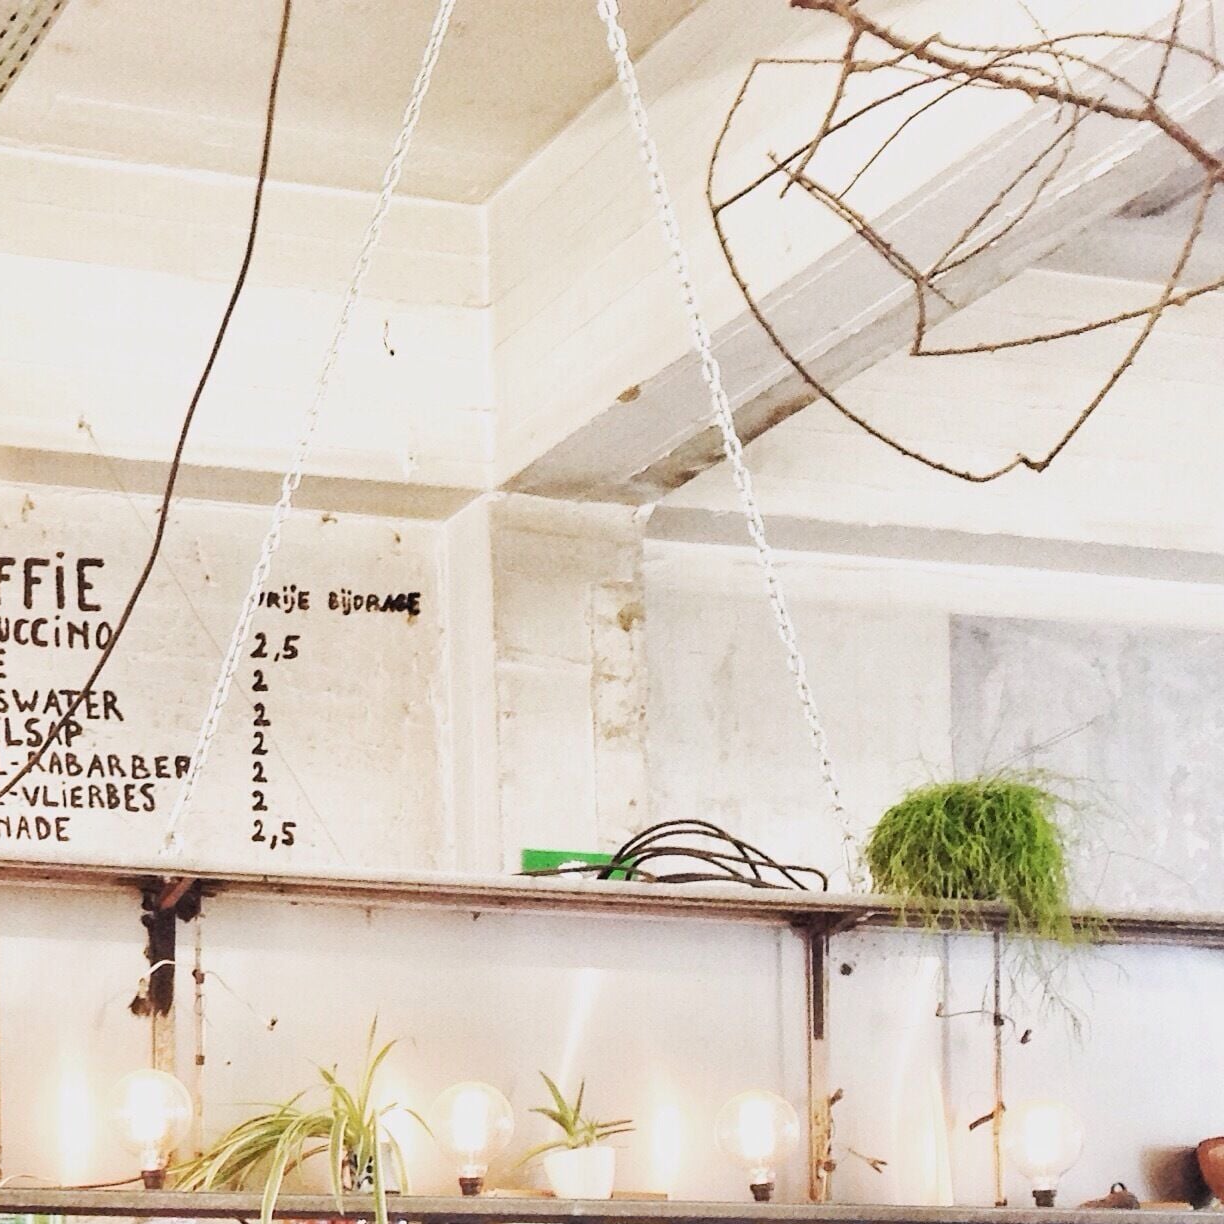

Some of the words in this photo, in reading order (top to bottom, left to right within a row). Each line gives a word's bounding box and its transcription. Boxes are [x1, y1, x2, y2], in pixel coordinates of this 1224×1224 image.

[250, 632, 301, 662] 2,5
[251, 669, 269, 692] 2
[253, 702, 271, 726] 2
[251, 731, 269, 756] 2
[252, 761, 268, 783] 2
[251, 790, 268, 812] 2
[251, 819, 297, 850] 2,5
